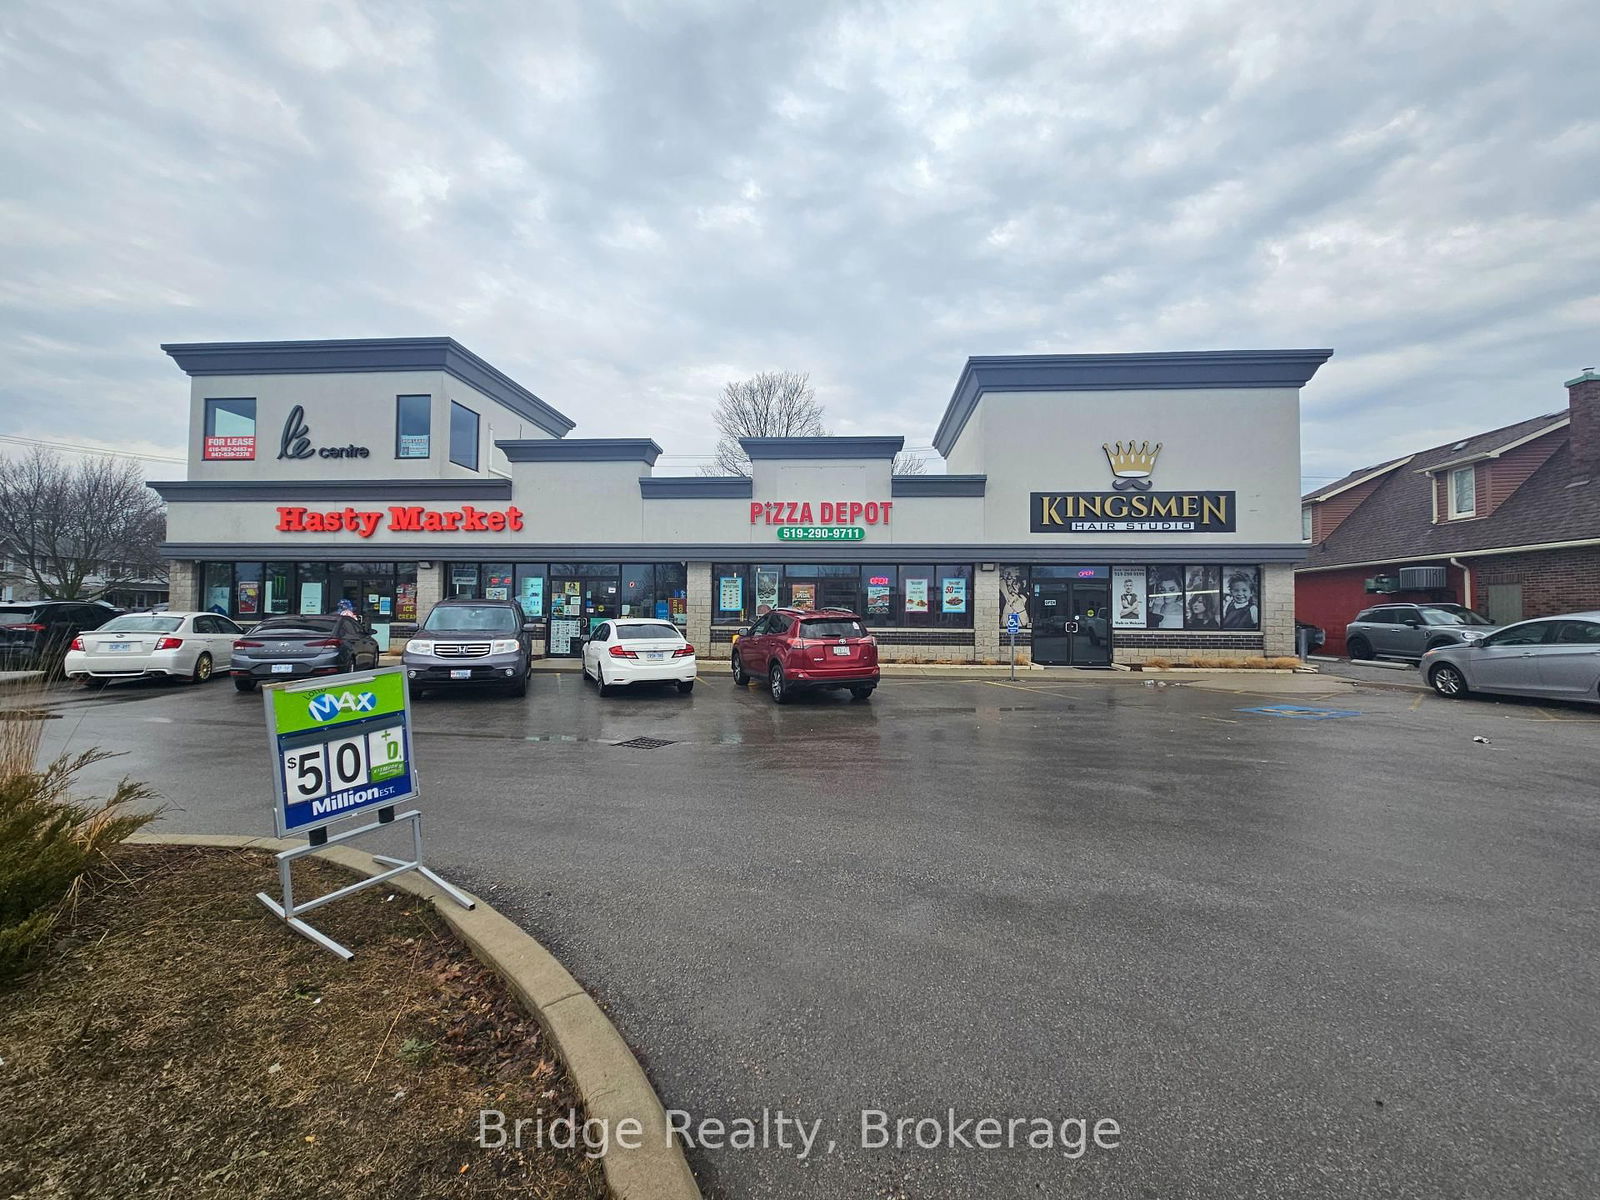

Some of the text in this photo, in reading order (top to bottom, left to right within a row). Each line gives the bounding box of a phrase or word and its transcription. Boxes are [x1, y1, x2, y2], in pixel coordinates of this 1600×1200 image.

[208, 438, 254, 446] FOR LEASE
[318, 444, 370, 459] centre
[820, 501, 893, 524] DEPOT
[1041, 495, 1227, 525] KINGSMEN
[275, 506, 524, 539] Hasty Market
[783, 528, 859, 538] 519-290-9711
[1075, 522, 1192, 530] HAIR STUDIO
[308, 691, 374, 722] MAX
[312, 786, 396, 816] Million EST.
